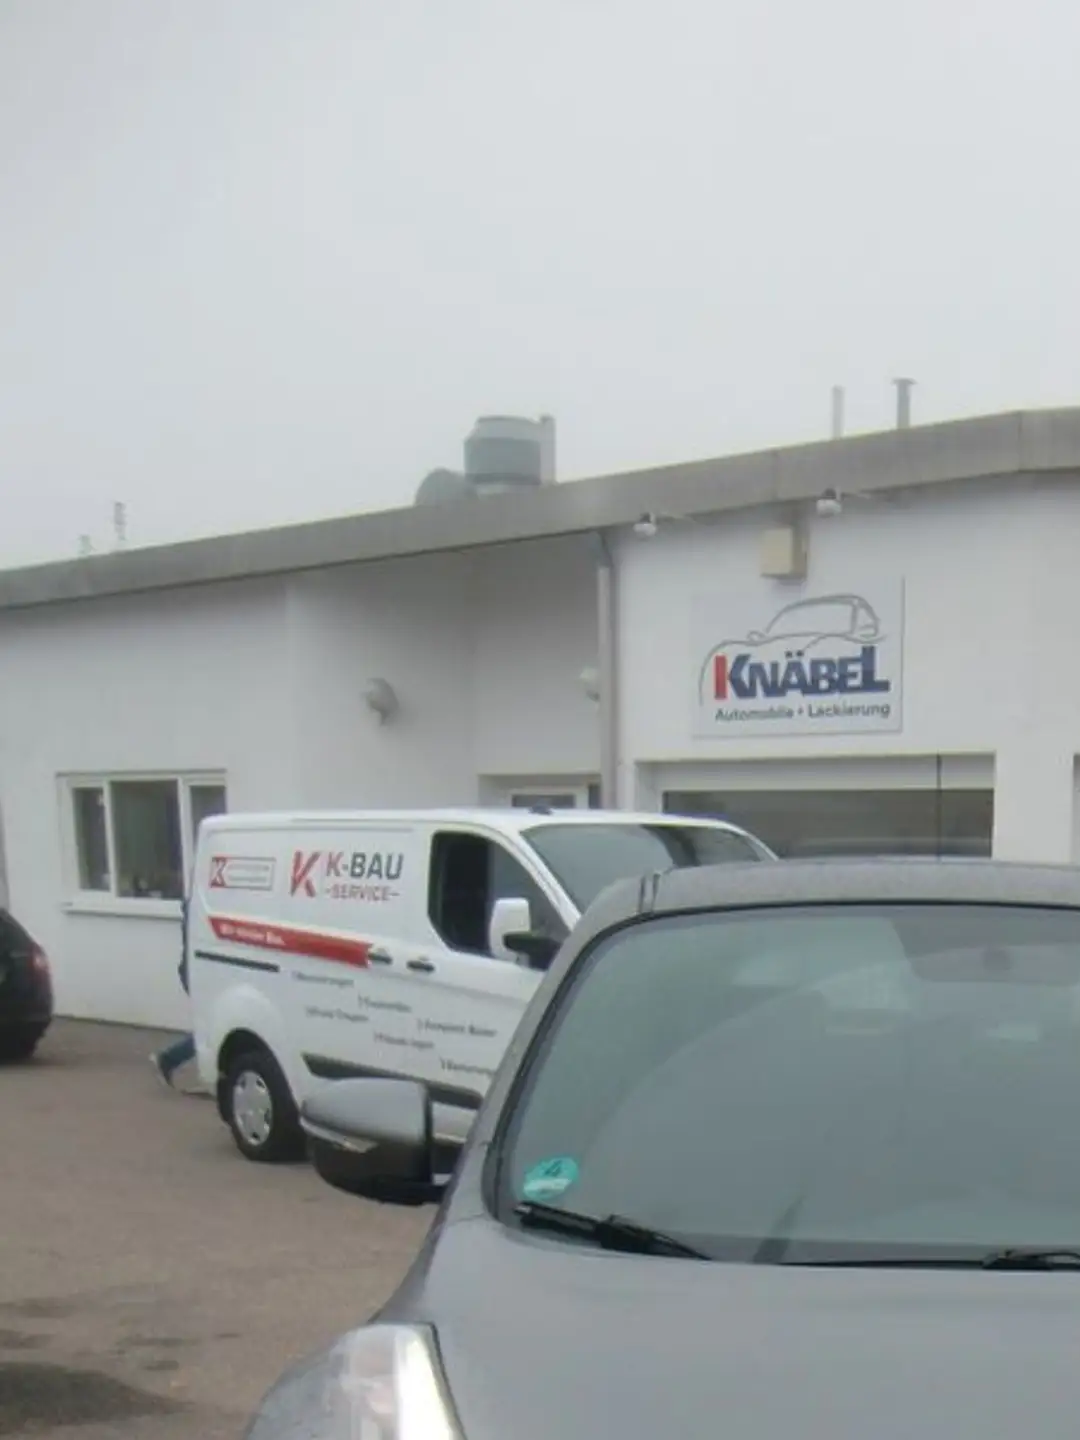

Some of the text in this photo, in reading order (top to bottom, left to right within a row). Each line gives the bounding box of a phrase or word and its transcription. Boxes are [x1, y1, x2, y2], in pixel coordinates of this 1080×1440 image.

[714, 645, 891, 701] KNÄBEL
[807, 702, 891, 719] Lackierung
[326, 851, 405, 881] K-BAU
